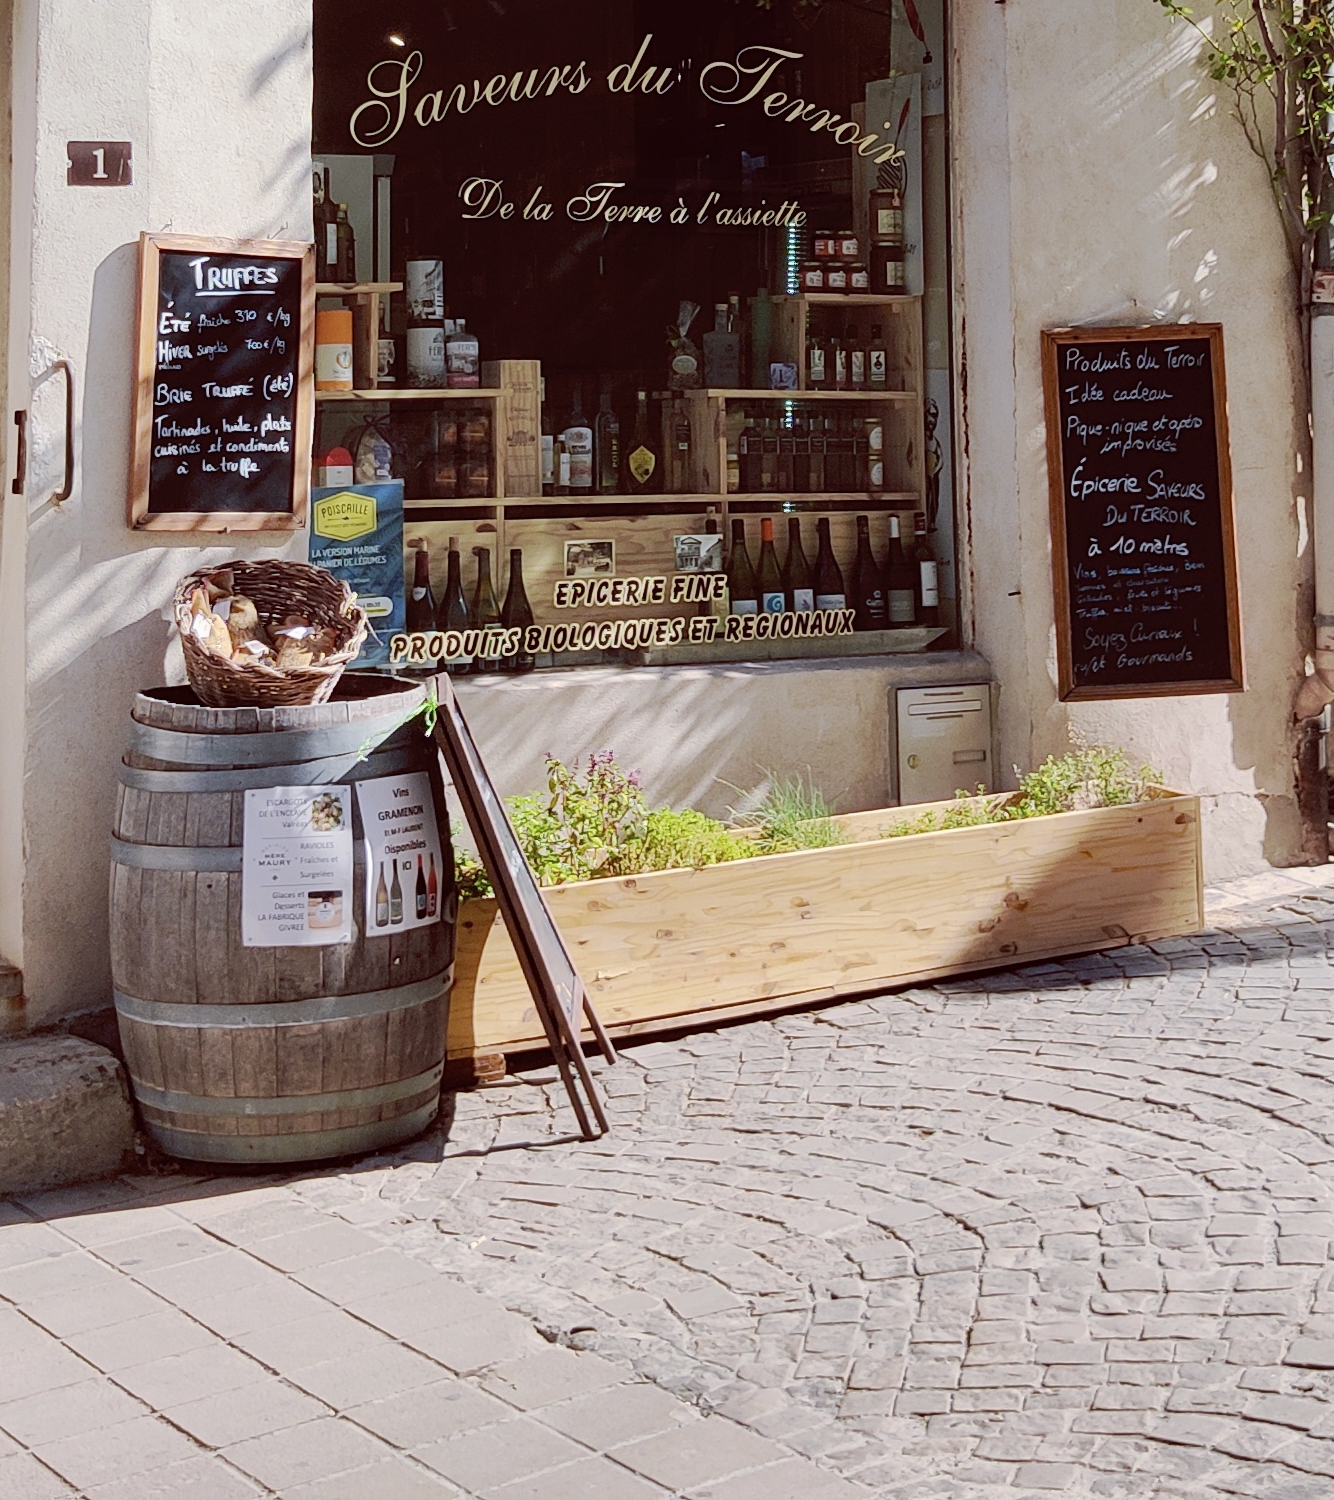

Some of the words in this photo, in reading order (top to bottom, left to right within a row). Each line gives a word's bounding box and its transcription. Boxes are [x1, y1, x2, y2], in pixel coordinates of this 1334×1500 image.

[349, 50, 591, 147] Saveurs
[607, 33, 675, 95] du
[699, 45, 906, 167] Terroir
[92, 148, 108, 179] 1
[458, 177, 515, 221] De
[522, 185, 554, 222] la
[566, 181, 663, 224] Terre
[669, 197, 690, 224] à
[697, 192, 808, 229] l'assiette
[1066, 347, 1131, 372] Produits
[1136, 346, 1160, 369] du
[1164, 345, 1205, 369] Terroir
[1065, 381, 1105, 404] Idée
[1113, 381, 1174, 401] cadeau
[260, 413, 291, 437] plats
[1152, 414, 1168, 431] et
[154, 439, 201, 457] cuisinés
[208, 437, 223, 453] et
[226, 437, 290, 453] condiments
[1100, 435, 1177, 457] improvisés
[177, 461, 189, 474] à
[202, 459, 220, 472] la
[220, 456, 261, 478] truffe
[1070, 457, 1142, 500] Épicerie
[321, 502, 369, 519] POISCAILLE
[1130, 504, 1197, 526] TERROIR
[311, 549, 322, 558] LA
[322, 546, 352, 558] VERSION
[353, 544, 381, 555] MARINE
[1088, 537, 1102, 557] à
[1109, 535, 1135, 554] 10
[344, 557, 354, 567] DE
[554, 577, 666, 609] EPICERIE
[670, 573, 728, 603] FINE
[390, 627, 521, 663] PRODUITS
[525, 618, 684, 653] BIOLOGIQUES
[685, 616, 719, 643] ET
[724, 609, 855, 642] REGIONAUX
[1083, 627, 1127, 652] Soyez
[1117, 645, 1193, 668] Gourmands
[392, 788, 409, 798] Vins
[259, 810, 268, 818] DE
[378, 804, 424, 821] GRAMENON
[300, 841, 334, 849] RAVIOLES
[385, 839, 427, 854] Disponibles
[300, 871, 334, 880] Surgelées
[272, 891, 298, 899] Glaces
[274, 902, 305, 910] Desserts
[258, 913, 266, 921] LA
[268, 912, 305, 921] FABRIQUE
